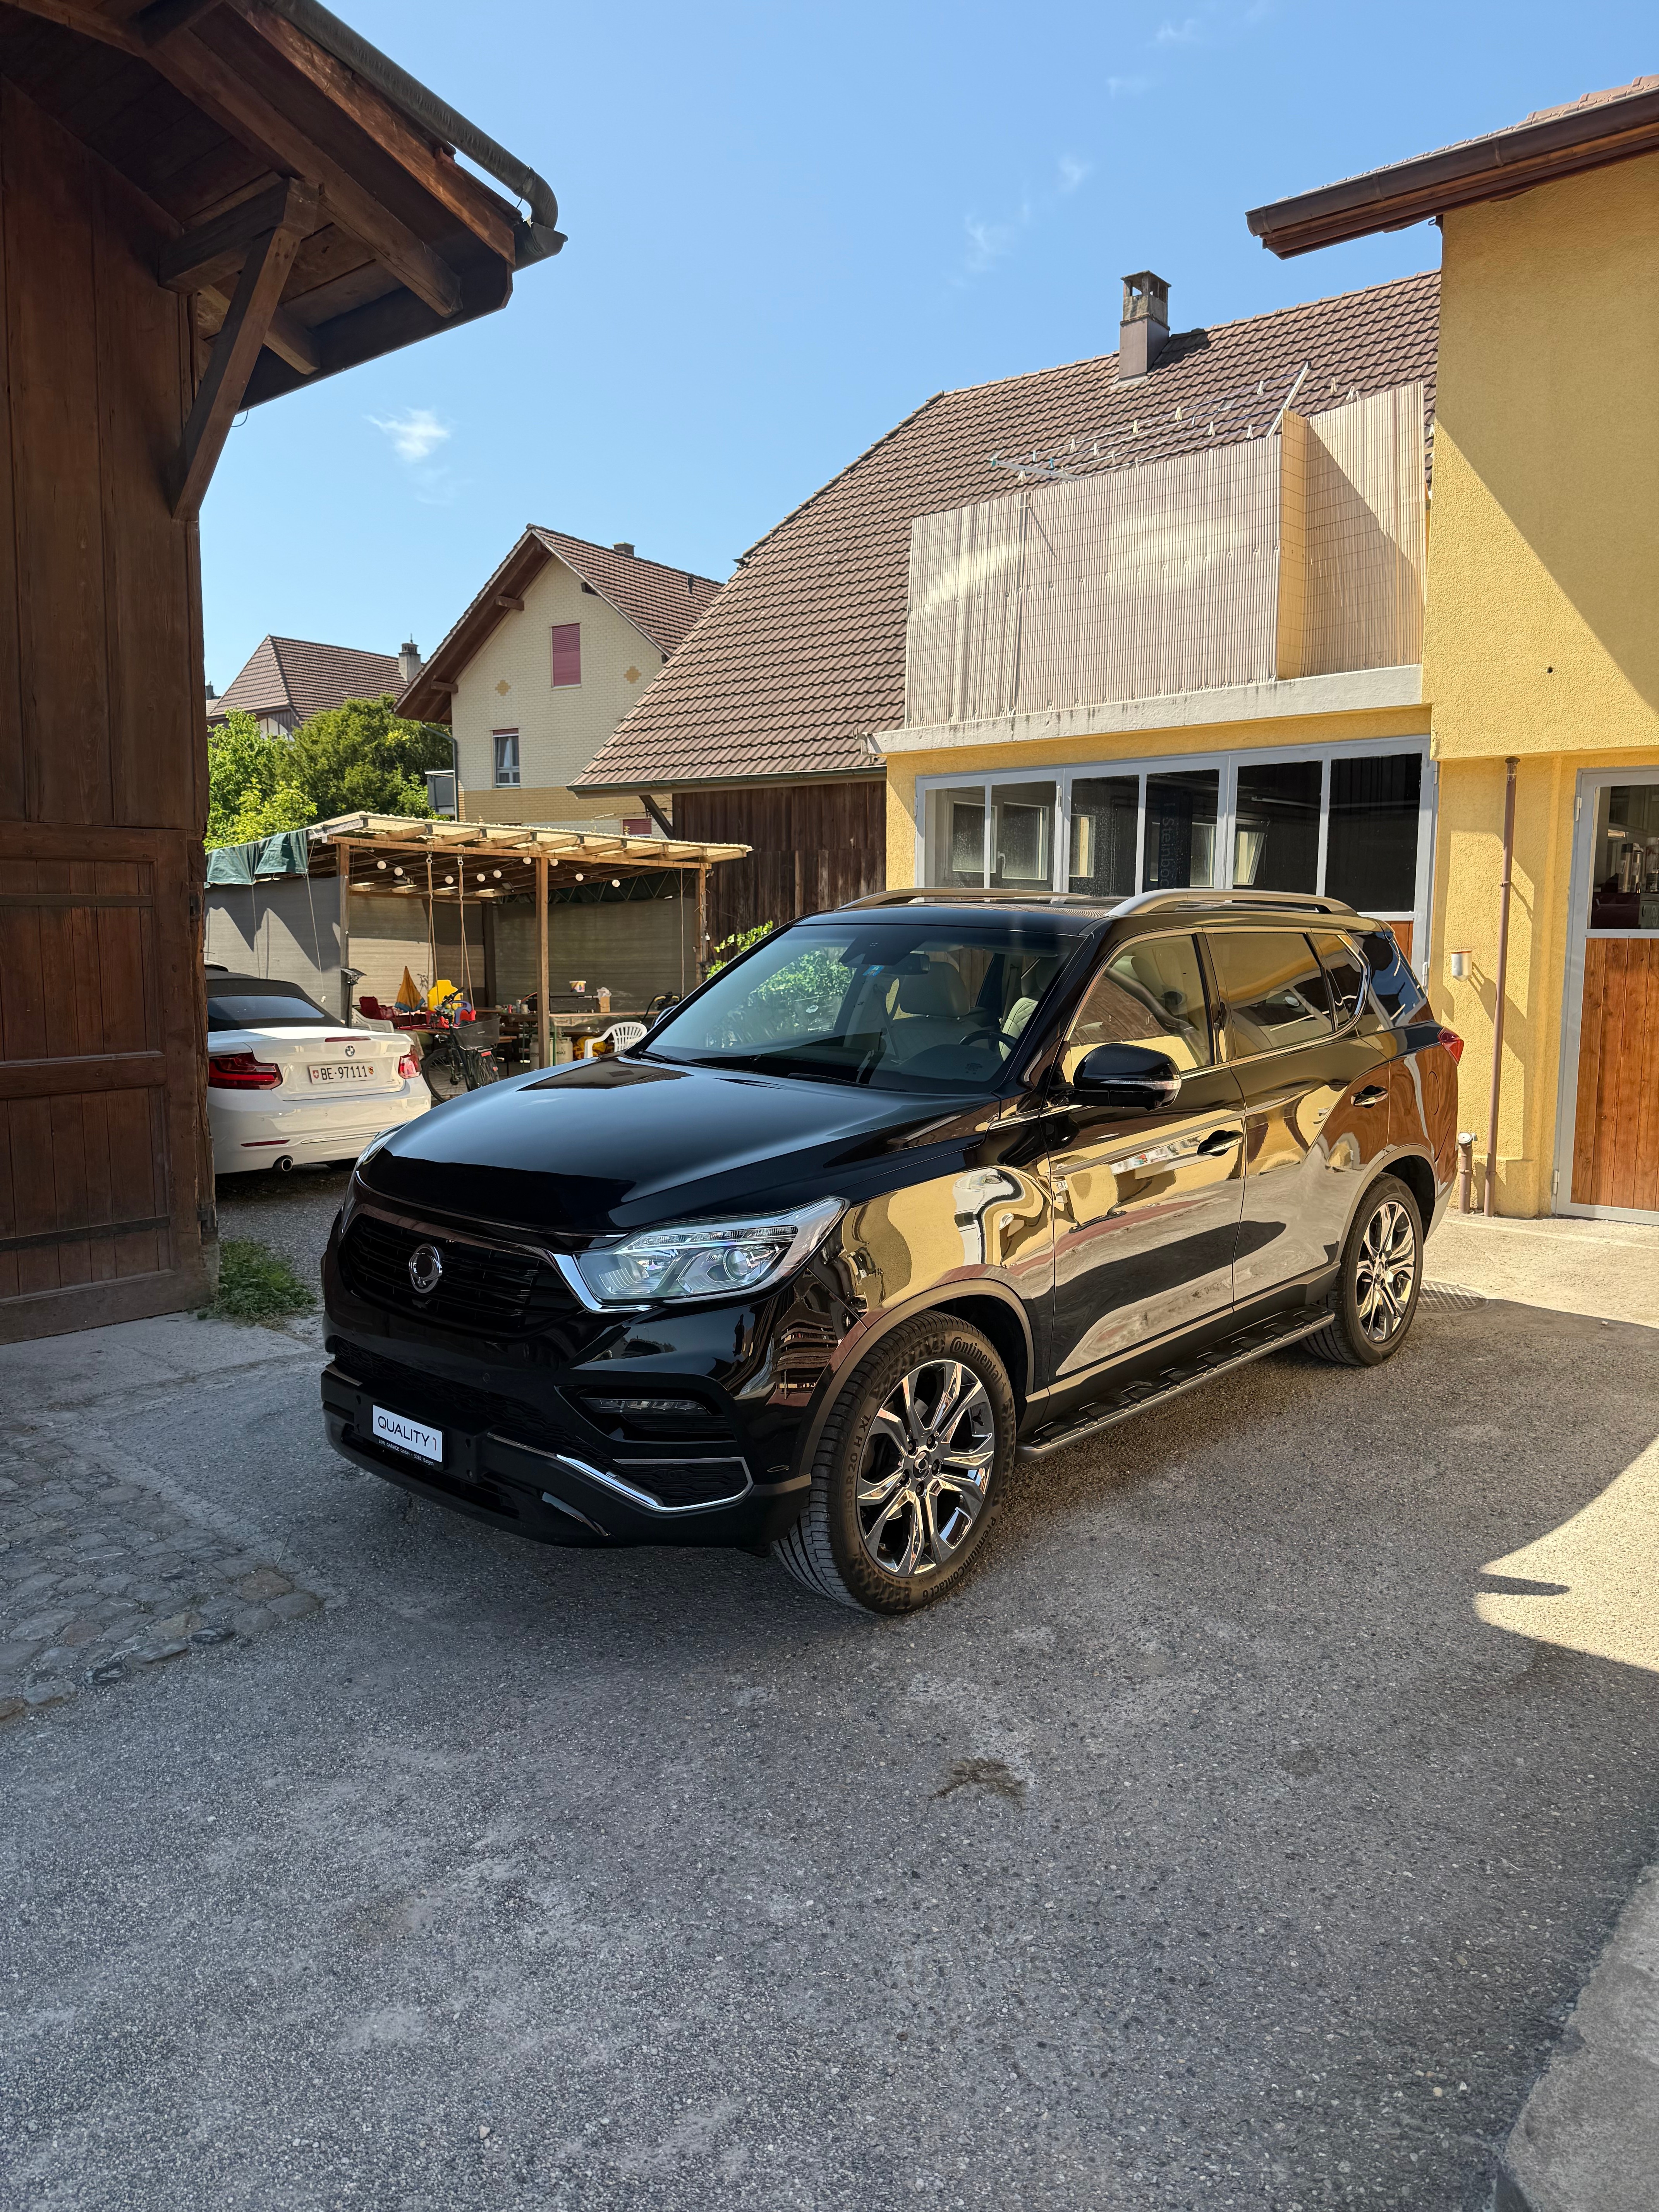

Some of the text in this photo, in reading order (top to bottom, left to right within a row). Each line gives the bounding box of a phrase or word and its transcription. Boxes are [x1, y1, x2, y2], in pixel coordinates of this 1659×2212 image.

[950, 1336, 1003, 1385] Continental
[378, 1416, 430, 1447] QUALITY
[859, 1415, 871, 1432] XL
[854, 1435, 862, 1448] H
[848, 1453, 858, 1472] 20
[846, 1475, 854, 1485] R
[922, 1516, 996, 1601] PremiumContact 6
